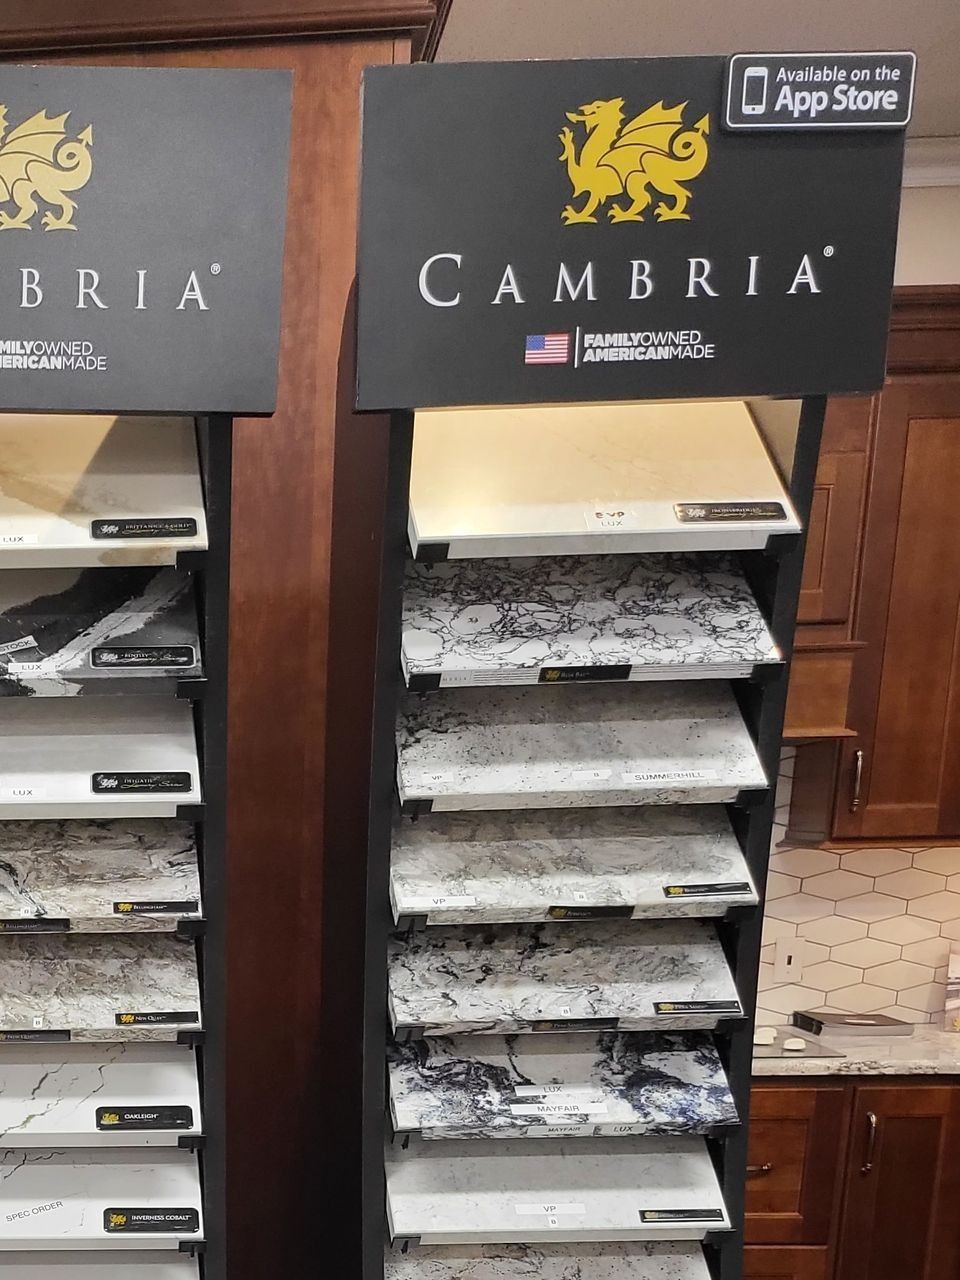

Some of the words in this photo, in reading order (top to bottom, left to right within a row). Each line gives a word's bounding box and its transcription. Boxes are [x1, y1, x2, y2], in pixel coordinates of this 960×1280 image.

[776, 65, 847, 82] Available
[850, 69, 870, 81] on
[875, 65, 901, 80] the
[774, 84, 829, 118] App
[831, 83, 899, 111] Store
[2, 535, 25, 543] LUX
[21, 663, 43, 671] LUX
[634, 770, 705, 782] SUMMERHILL
[537, 1105, 580, 1113] MAYFAIR
[613, 1125, 634, 1133] LUX
[5, 1210, 30, 1223] SPEC
[31, 1201, 64, 1216] ORDER
[543, 1205, 557, 1213] VP
